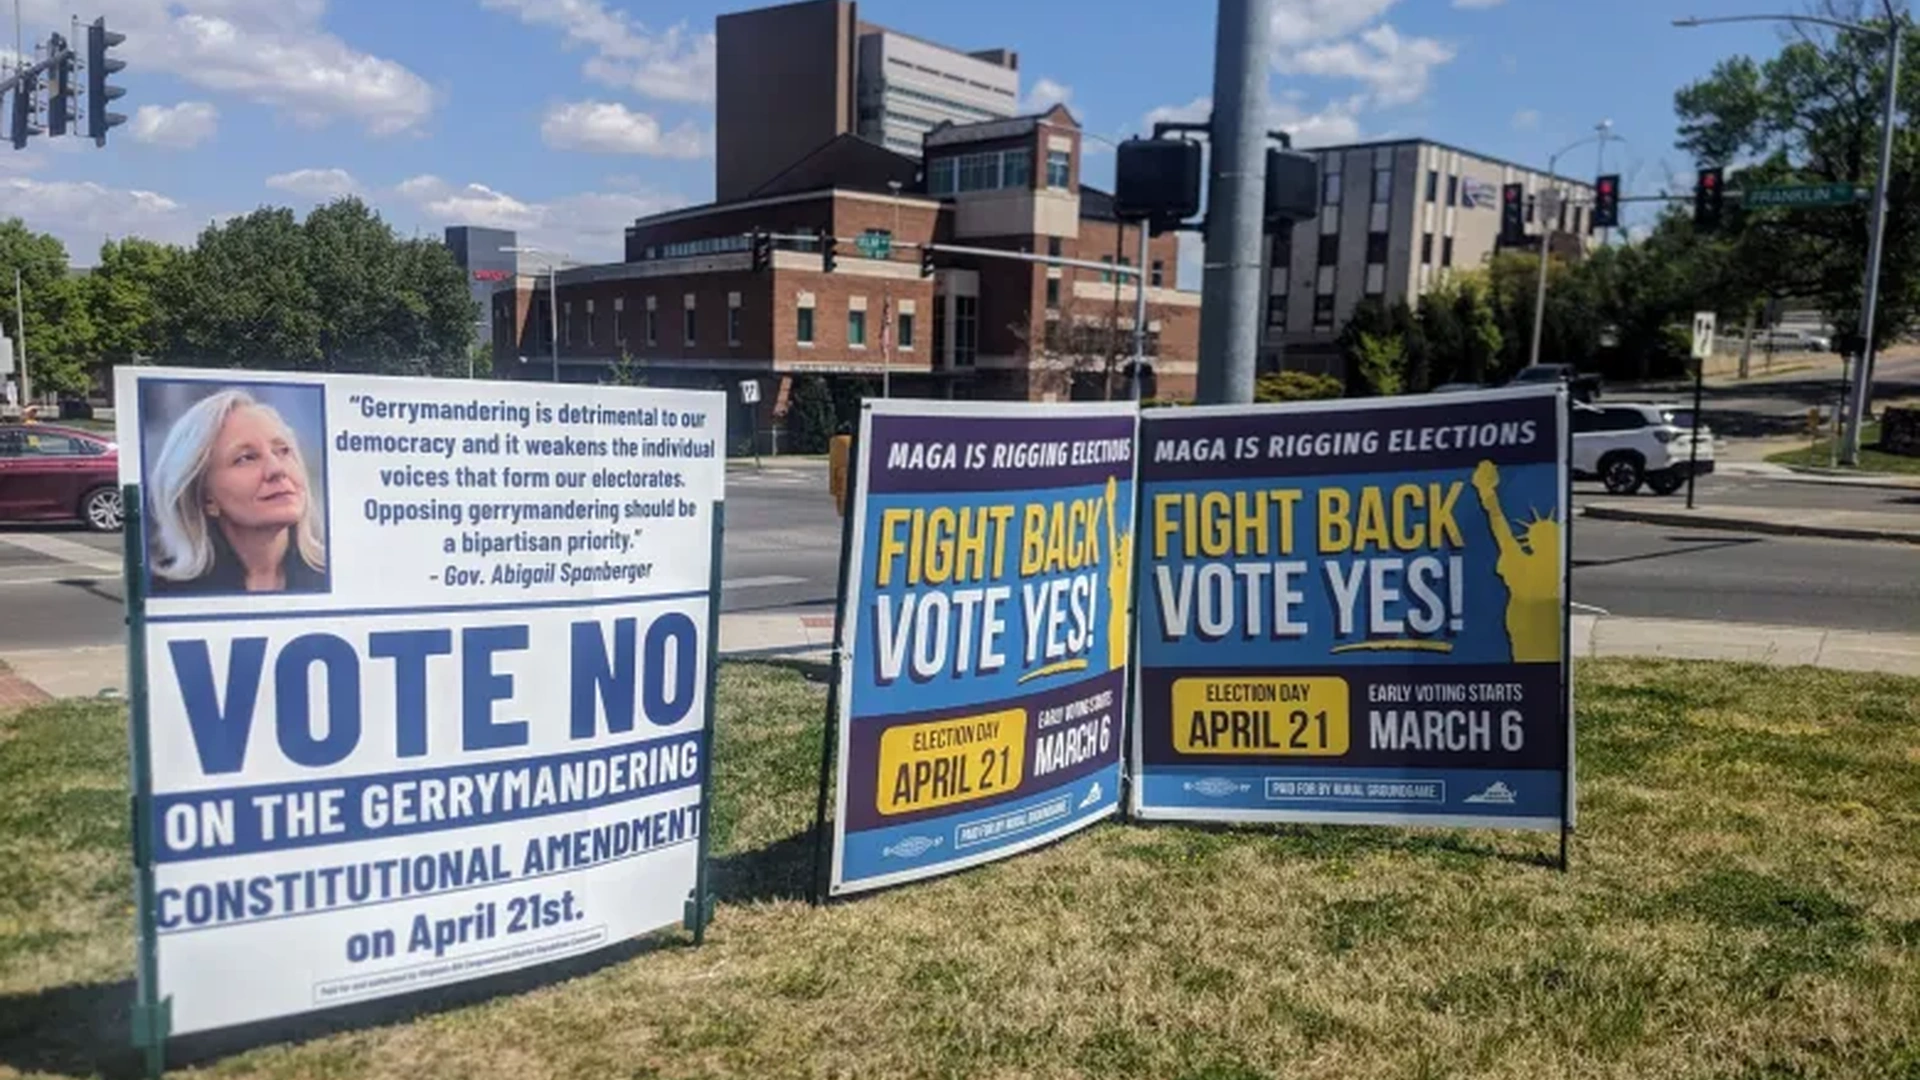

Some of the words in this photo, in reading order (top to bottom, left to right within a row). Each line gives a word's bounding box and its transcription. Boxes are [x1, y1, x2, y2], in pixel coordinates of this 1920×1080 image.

[349, 396, 530, 428] “Gerrymandering
[536, 402, 552, 423] is
[558, 403, 658, 427] detrimental
[662, 409, 677, 427] to
[681, 412, 706, 428] our
[336, 430, 456, 458] democracy
[462, 434, 499, 454] and
[506, 433, 520, 454] it
[526, 435, 607, 456] weakens
[612, 438, 638, 457] the
[642, 437, 715, 458] individual
[887, 442, 957, 470] MAGA
[964, 443, 985, 469] IS
[992, 442, 1068, 469] RIGGING
[1154, 438, 1226, 462] MAGA
[1234, 437, 1260, 459] IS
[1268, 430, 1379, 458] RIGGING
[1388, 420, 1537, 452] ELECTIONS
[381, 465, 449, 487] voices
[456, 466, 497, 487] that
[502, 467, 549, 488] form
[555, 471, 586, 488] our
[592, 468, 685, 488] electorates.
[364, 499, 462, 526] Opposing
[468, 499, 619, 525] gerrymandering
[624, 499, 675, 518] should
[679, 499, 697, 517] be
[1153, 488, 1304, 558] FIGHT
[1317, 481, 1465, 554] BACK
[443, 538, 455, 553] a
[462, 531, 561, 557] bipartisan
[877, 506, 1015, 587] FIGHT
[1020, 498, 1103, 577] BACK
[444, 565, 485, 586] Gov.
[491, 563, 555, 589] Abigail
[560, 561, 653, 587] Spanberger
[1156, 560, 1308, 637] VOTE
[1324, 556, 1464, 635] YES!
[876, 586, 1011, 680] VOTE
[1023, 573, 1098, 662] YES!
[167, 623, 529, 775] VOTE
[570, 612, 697, 740] NO
[1206, 684, 1276, 702] ELECTION
[1279, 684, 1310, 702] DAY
[1368, 684, 1411, 702] EARLY
[1415, 684, 1466, 702] VOTING
[1469, 684, 1523, 702] STARTS
[913, 725, 974, 751] ELECTION
[976, 721, 999, 741] DAY
[1033, 719, 1098, 777] MARCH
[1100, 714, 1111, 752] 6
[1189, 711, 1280, 748] APRIL
[1289, 710, 1327, 748] 21
[1370, 710, 1490, 750] MARCH
[1500, 709, 1524, 751] 6
[164, 800, 235, 850] ON
[252, 789, 345, 841] THE
[361, 740, 698, 829] GERRYMANDERING
[892, 754, 971, 806] APRIL
[979, 745, 1010, 790] 21
[156, 845, 511, 929] CONSTITUTIONAL
[522, 804, 700, 875] AMENDMENT
[346, 929, 395, 963] on
[407, 902, 495, 957] April
[507, 891, 584, 935] 21st.
